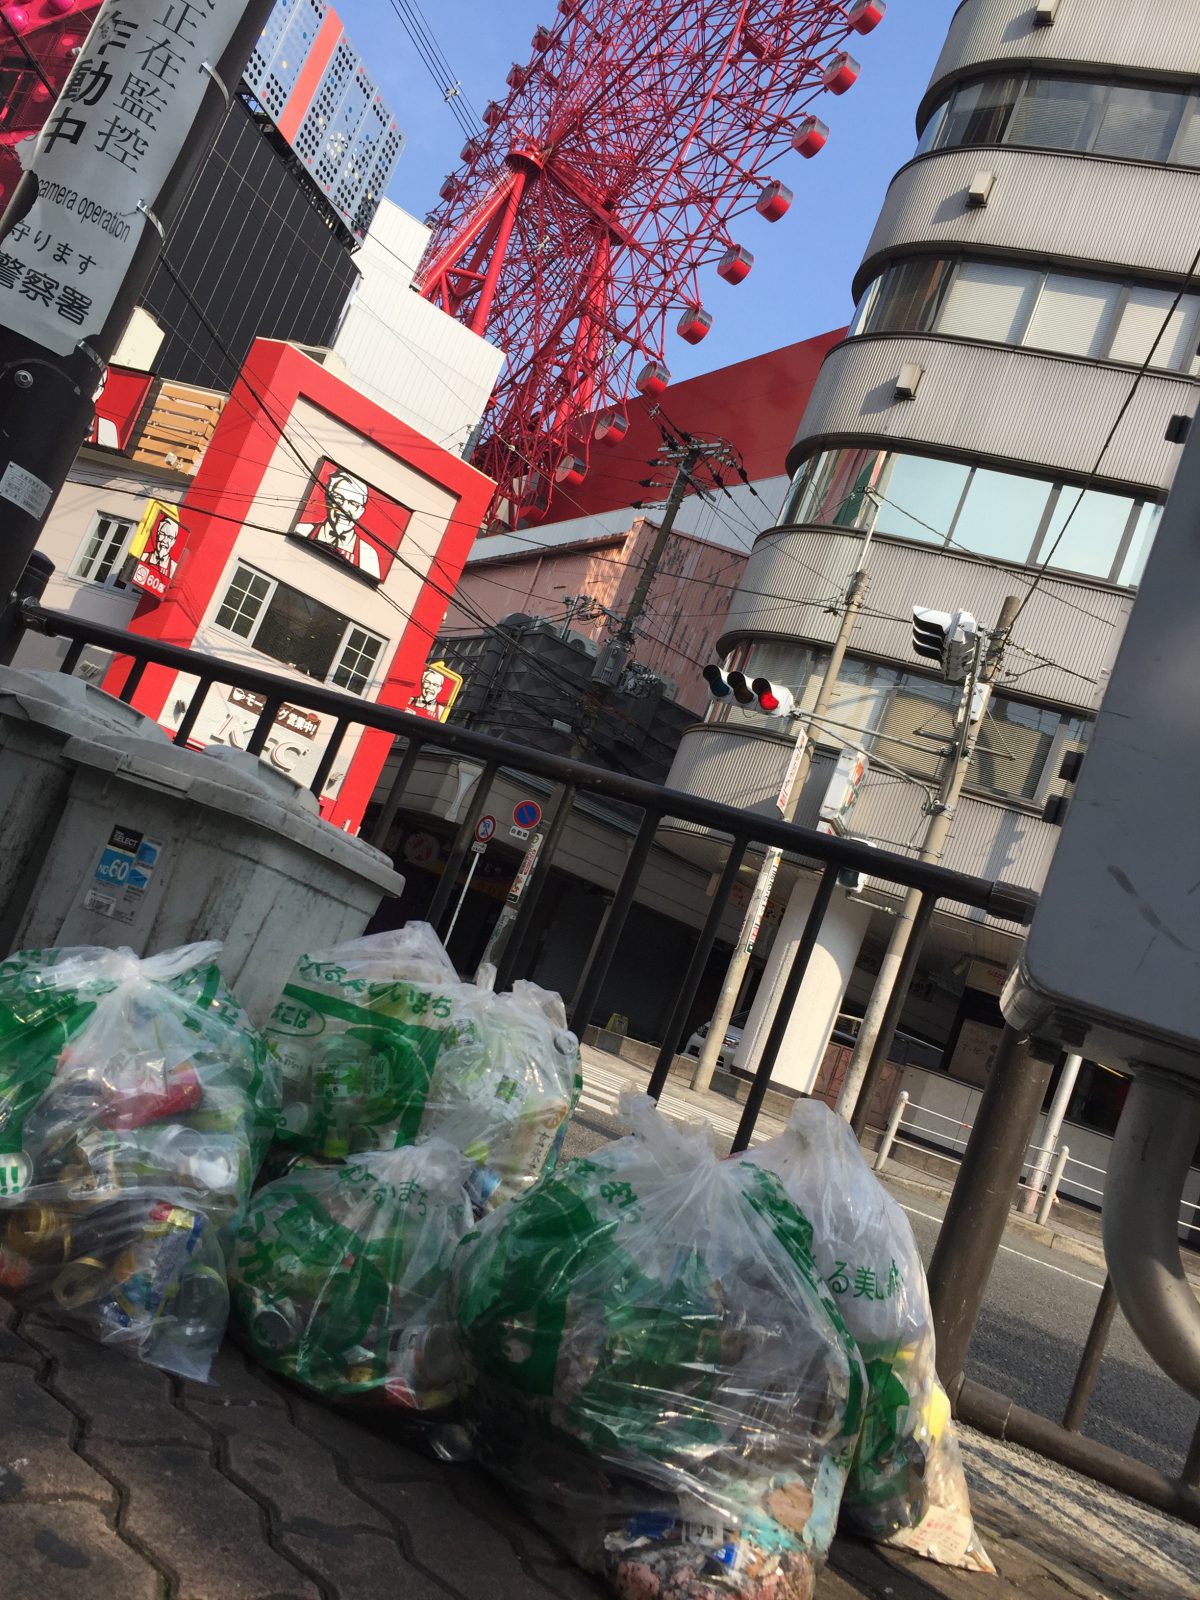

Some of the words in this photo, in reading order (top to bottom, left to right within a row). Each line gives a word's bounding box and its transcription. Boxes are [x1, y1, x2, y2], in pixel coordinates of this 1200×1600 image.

[77, 197, 131, 243] operation
[0, 251, 93, 326] 警察署
